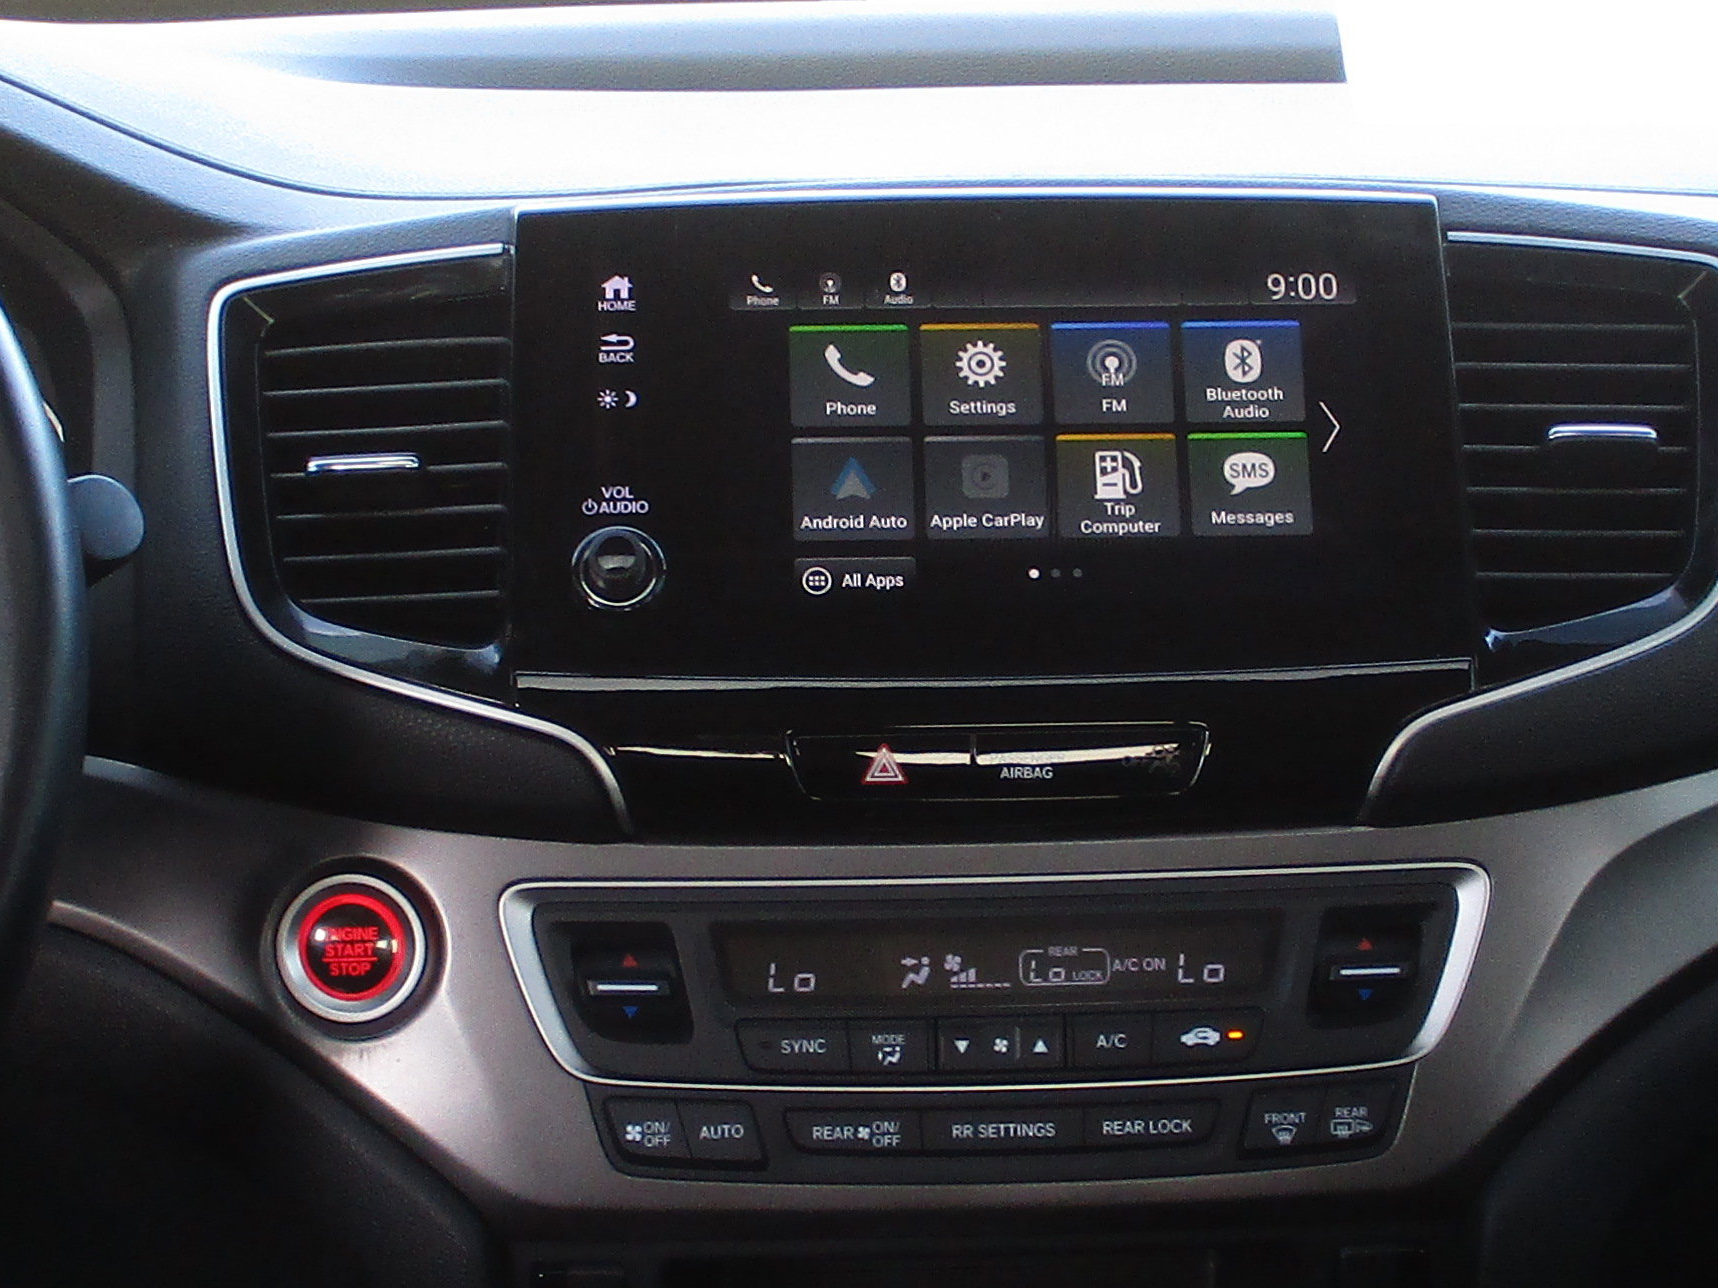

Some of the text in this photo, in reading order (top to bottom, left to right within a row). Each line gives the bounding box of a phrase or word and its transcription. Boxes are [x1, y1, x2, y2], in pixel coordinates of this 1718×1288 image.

[1266, 272, 1338, 300] 9:00
[597, 300, 637, 312] HOME
[746, 294, 780, 306] Phone
[822, 294, 839, 306] FM
[883, 293, 914, 306] Audio
[598, 351, 635, 364] BACK
[1205, 387, 1284, 402] Bluetooth
[825, 401, 877, 416] Phone
[948, 399, 1017, 416] Settings
[1102, 399, 1127, 412] FM
[1222, 405, 1270, 419] Audio
[1229, 462, 1269, 479] SMS
[601, 485, 635, 500] VOL
[599, 500, 649, 514] AUDIO
[1103, 501, 1136, 518] Trip
[800, 514, 908, 530] Android Auto
[929, 512, 1045, 531] Apple CarPlay
[1211, 510, 1295, 528] Messages
[1080, 520, 1162, 536] Computer
[841, 573, 905, 591] All Apps
[999, 766, 1054, 779] AIRBAG
[325, 942, 374, 957] START
[329, 963, 372, 977] STOP
[1030, 960, 1066, 983] Lo
[1111, 956, 1167, 972] A/C ON
[1177, 952, 1226, 983] Lo
[767, 962, 816, 993] Lo
[780, 1038, 828, 1054] SYNC
[871, 1034, 906, 1044] MODE
[1096, 1033, 1128, 1048] A/C
[1264, 1112, 1307, 1124] FRONT
[1334, 1106, 1369, 1118] REAR
[643, 1120, 671, 1134] ON/
[699, 1123, 745, 1139] AUTO
[811, 1120, 901, 1141] REAR ON/
[951, 1122, 1057, 1139] RR SETTINGS
[1102, 1118, 1193, 1135] REAR LOCK
[643, 1134, 671, 1147] OFF
[872, 1134, 902, 1148] OFF
